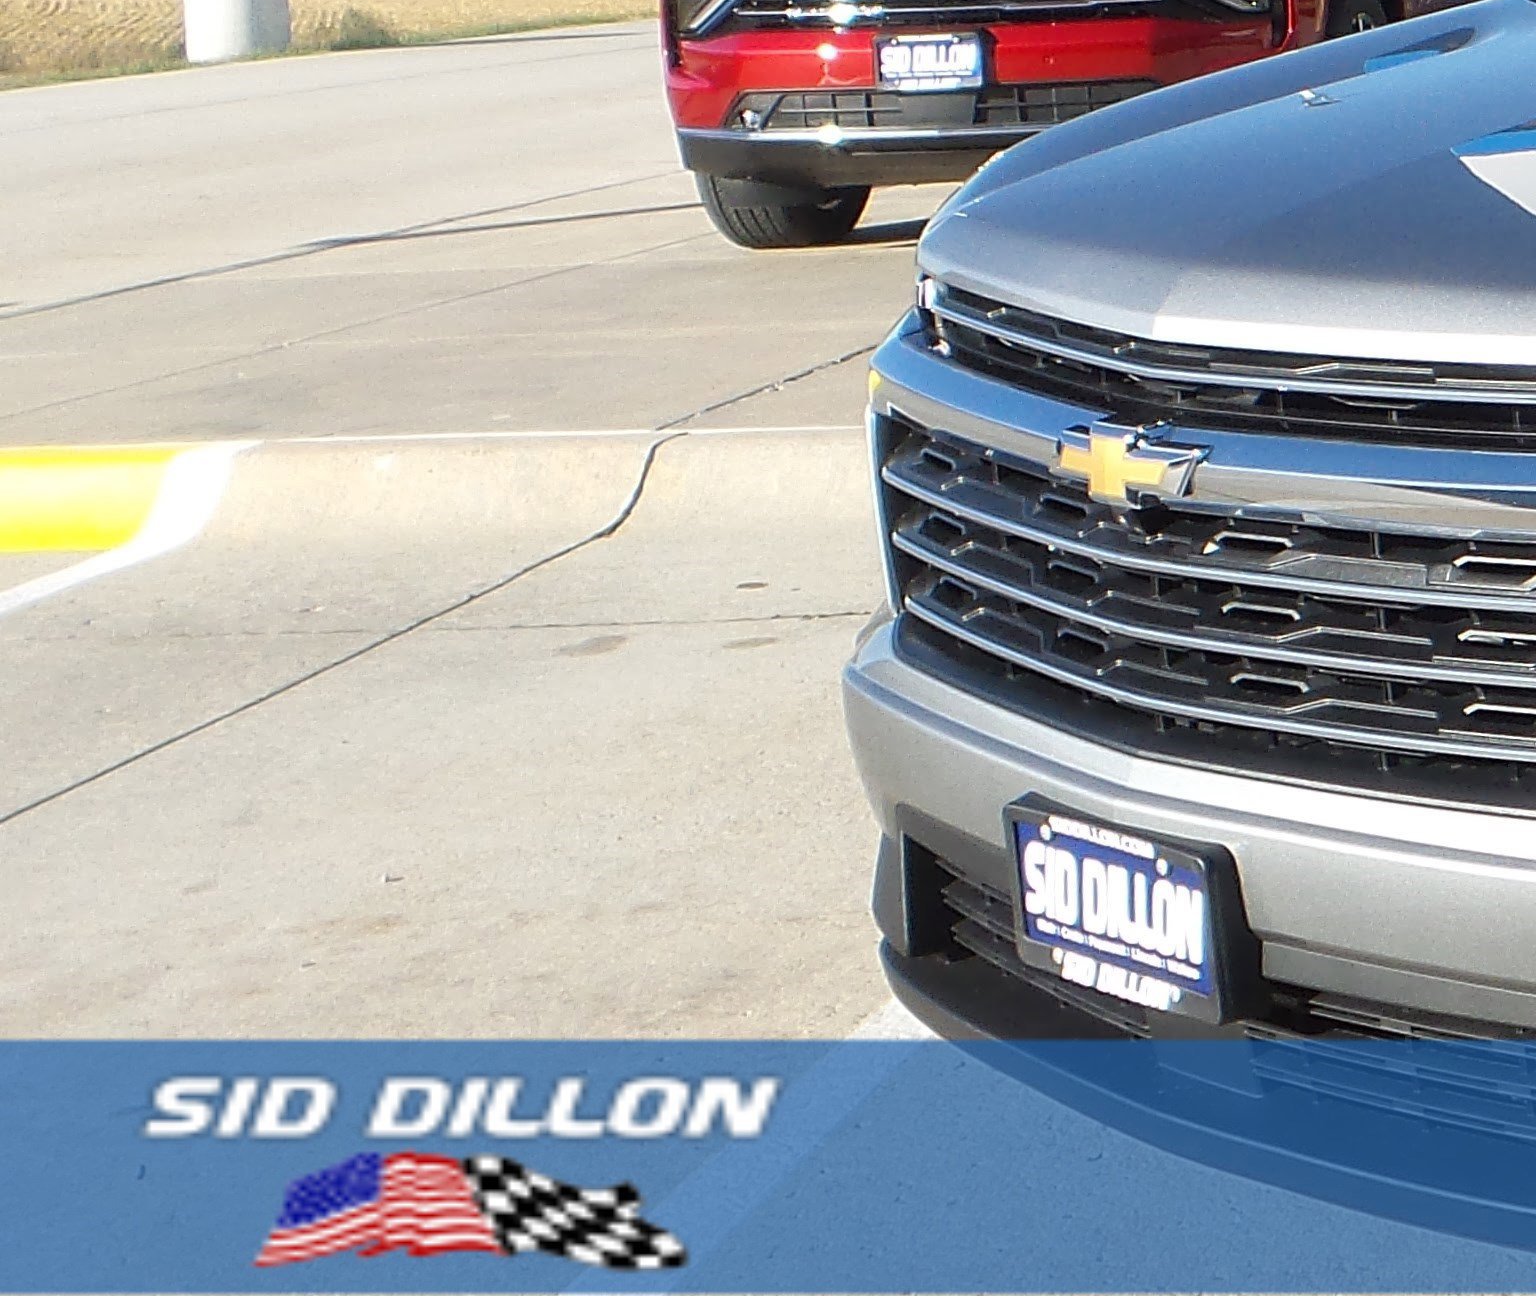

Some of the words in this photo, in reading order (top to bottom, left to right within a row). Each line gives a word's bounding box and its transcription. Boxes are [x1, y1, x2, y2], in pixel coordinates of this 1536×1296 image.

[912, 43, 977, 73] DILLON
[1024, 840, 1079, 926] SID
[1081, 856, 1204, 965] DILLON
